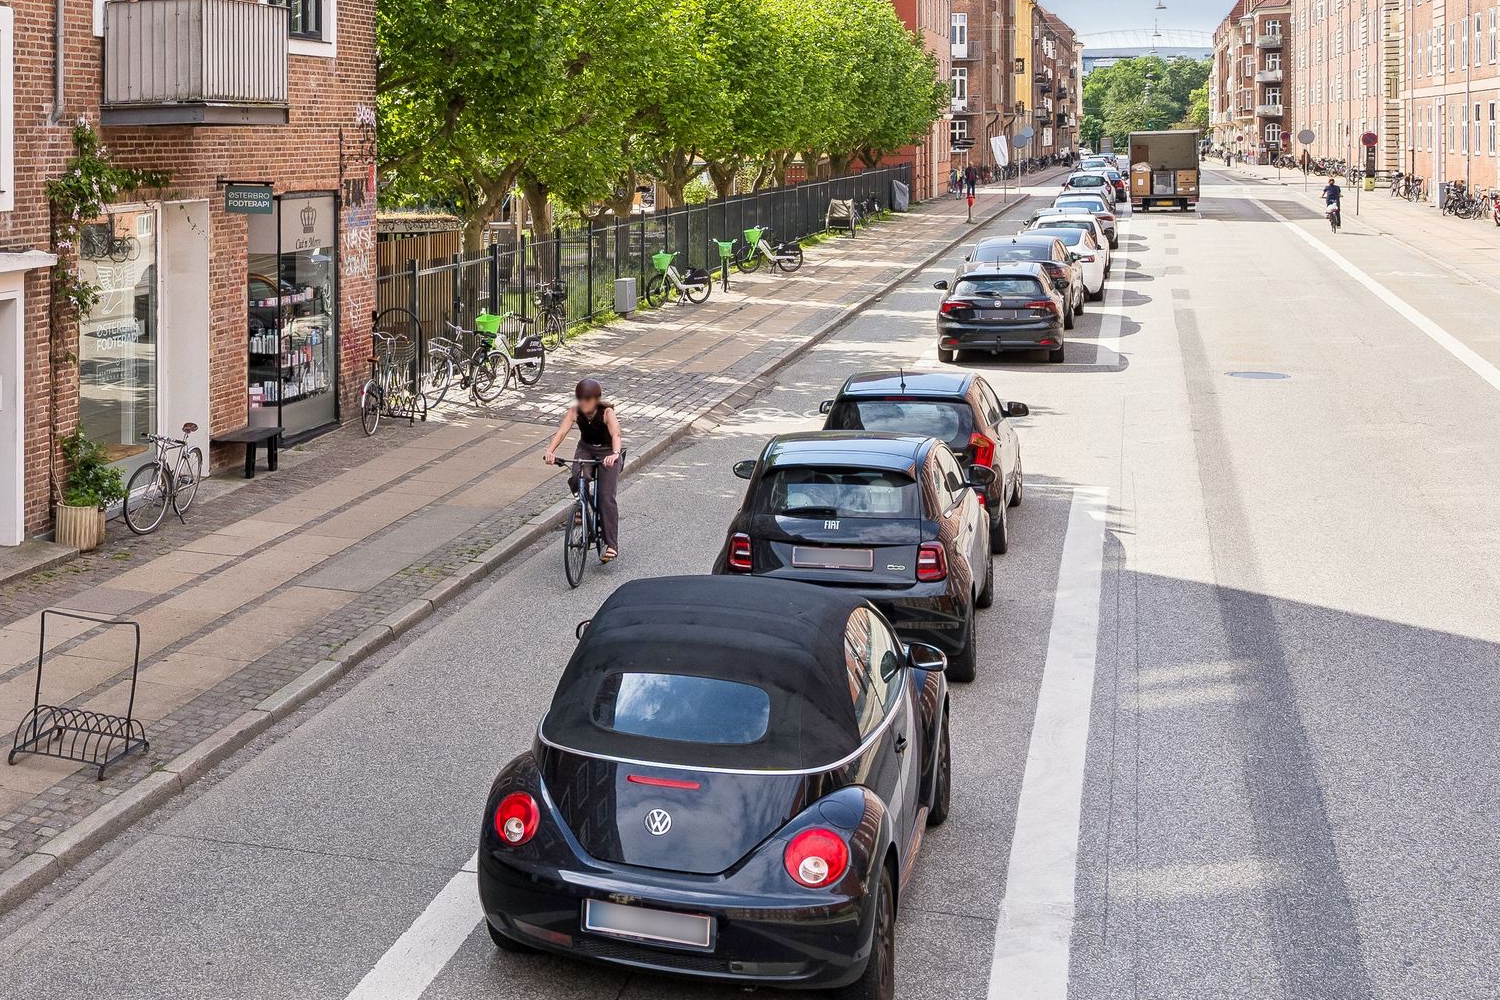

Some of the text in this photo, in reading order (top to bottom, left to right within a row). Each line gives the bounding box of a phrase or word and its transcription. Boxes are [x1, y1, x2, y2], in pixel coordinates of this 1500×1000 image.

[228, 191, 270, 200] ØSTERBRO
[228, 199, 270, 208] FODTERAPI
[824, 520, 840, 530] FIAT
